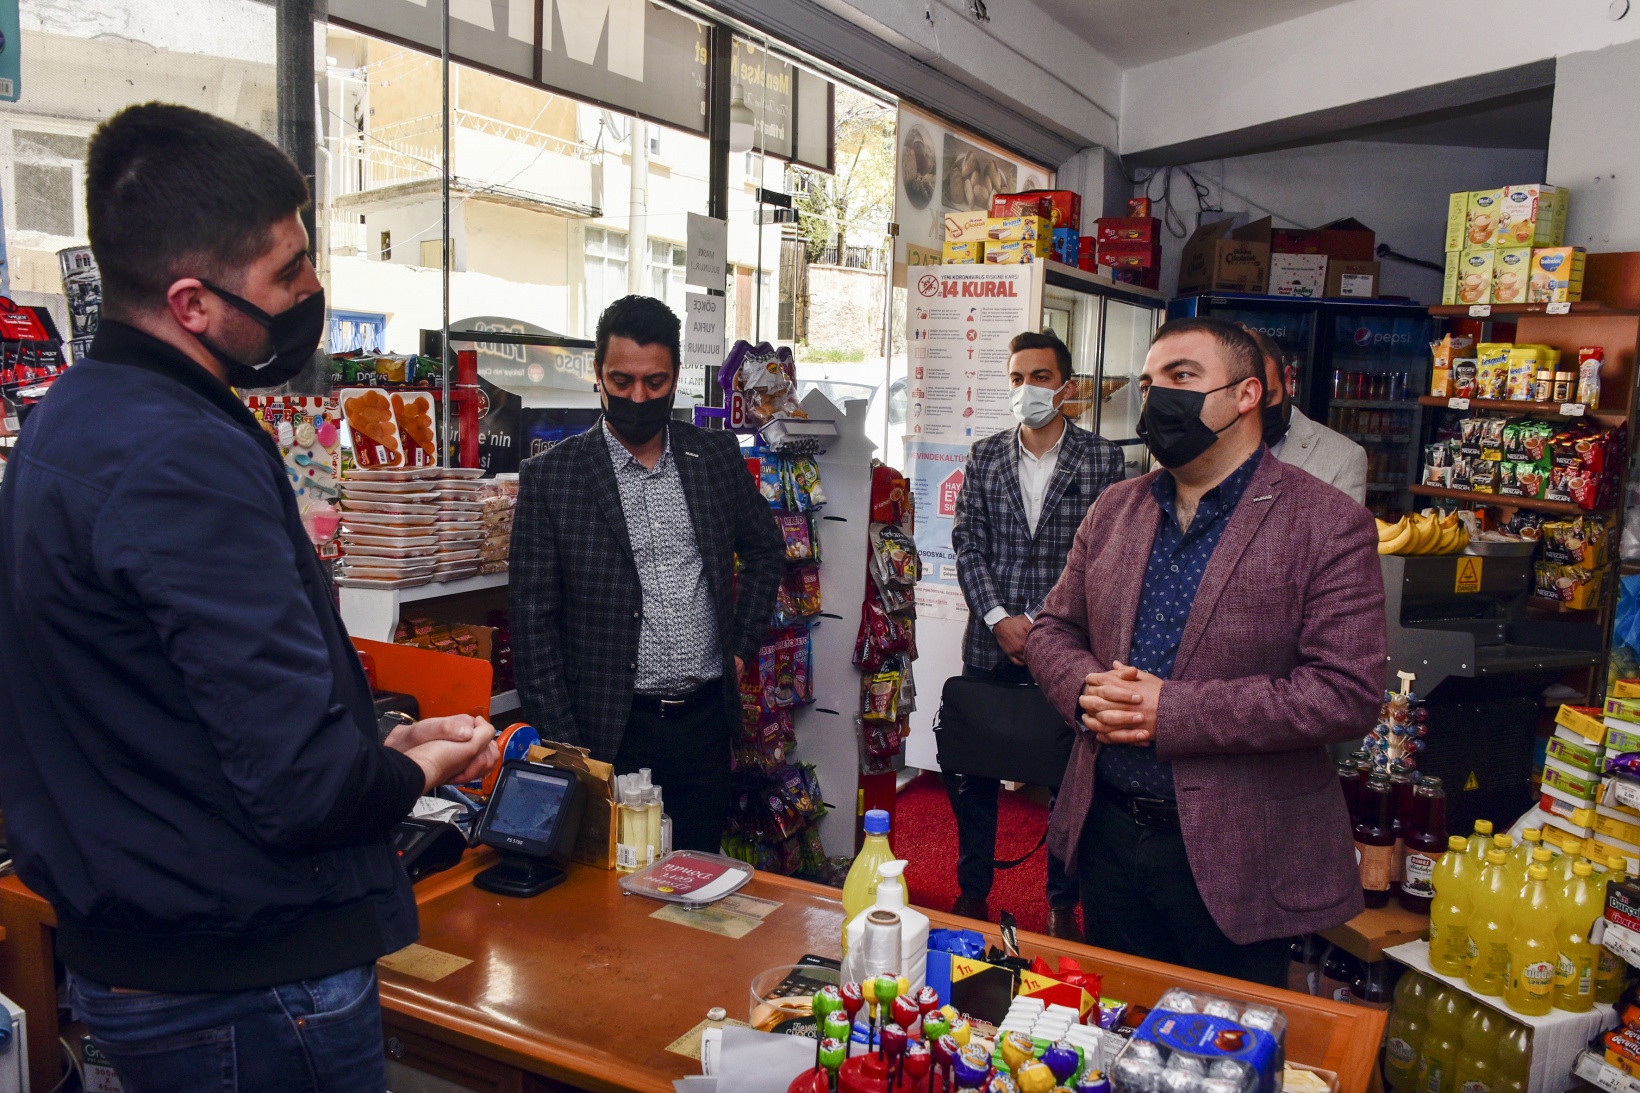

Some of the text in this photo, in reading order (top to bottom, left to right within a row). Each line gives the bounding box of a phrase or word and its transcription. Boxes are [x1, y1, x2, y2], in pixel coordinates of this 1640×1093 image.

[961, 281, 1018, 298] KURAL
[1373, 332, 1411, 345] pepsi
[661, 863, 713, 880] Döndü
